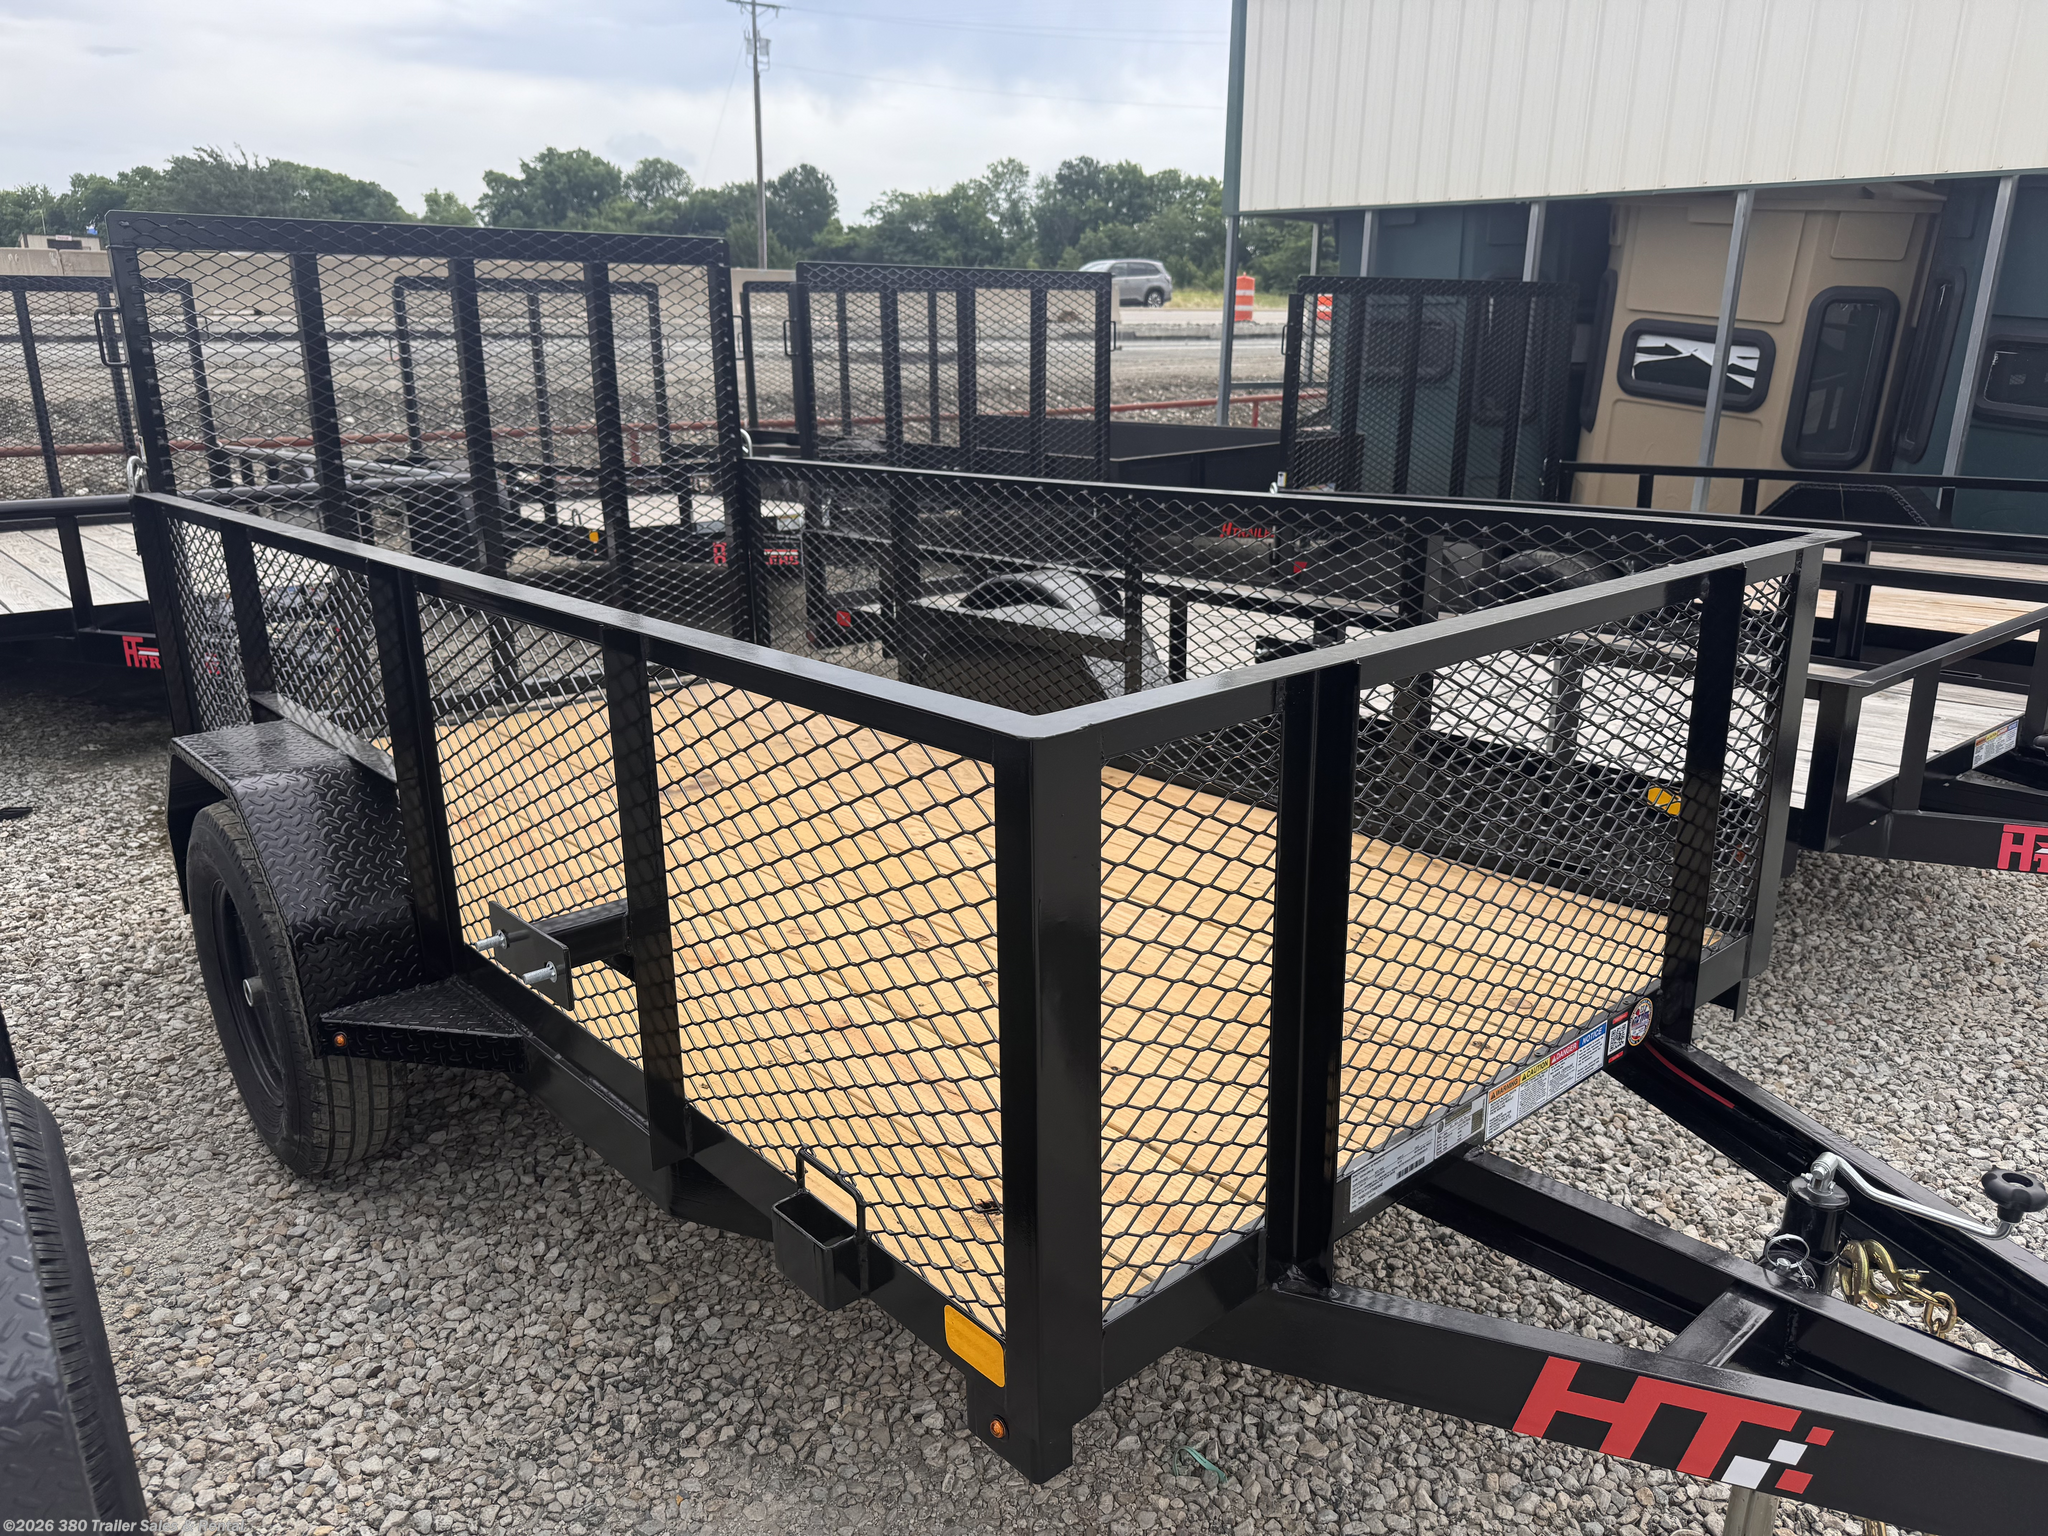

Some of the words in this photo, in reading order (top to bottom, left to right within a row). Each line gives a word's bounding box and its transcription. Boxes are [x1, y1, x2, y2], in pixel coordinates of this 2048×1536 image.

[1581, 1026, 1603, 1045] NOTICE
[1556, 1042, 1577, 1060] DANGER
[1526, 1060, 1549, 1078] CAUTION
[1496, 1078, 1519, 1096] WARNING
